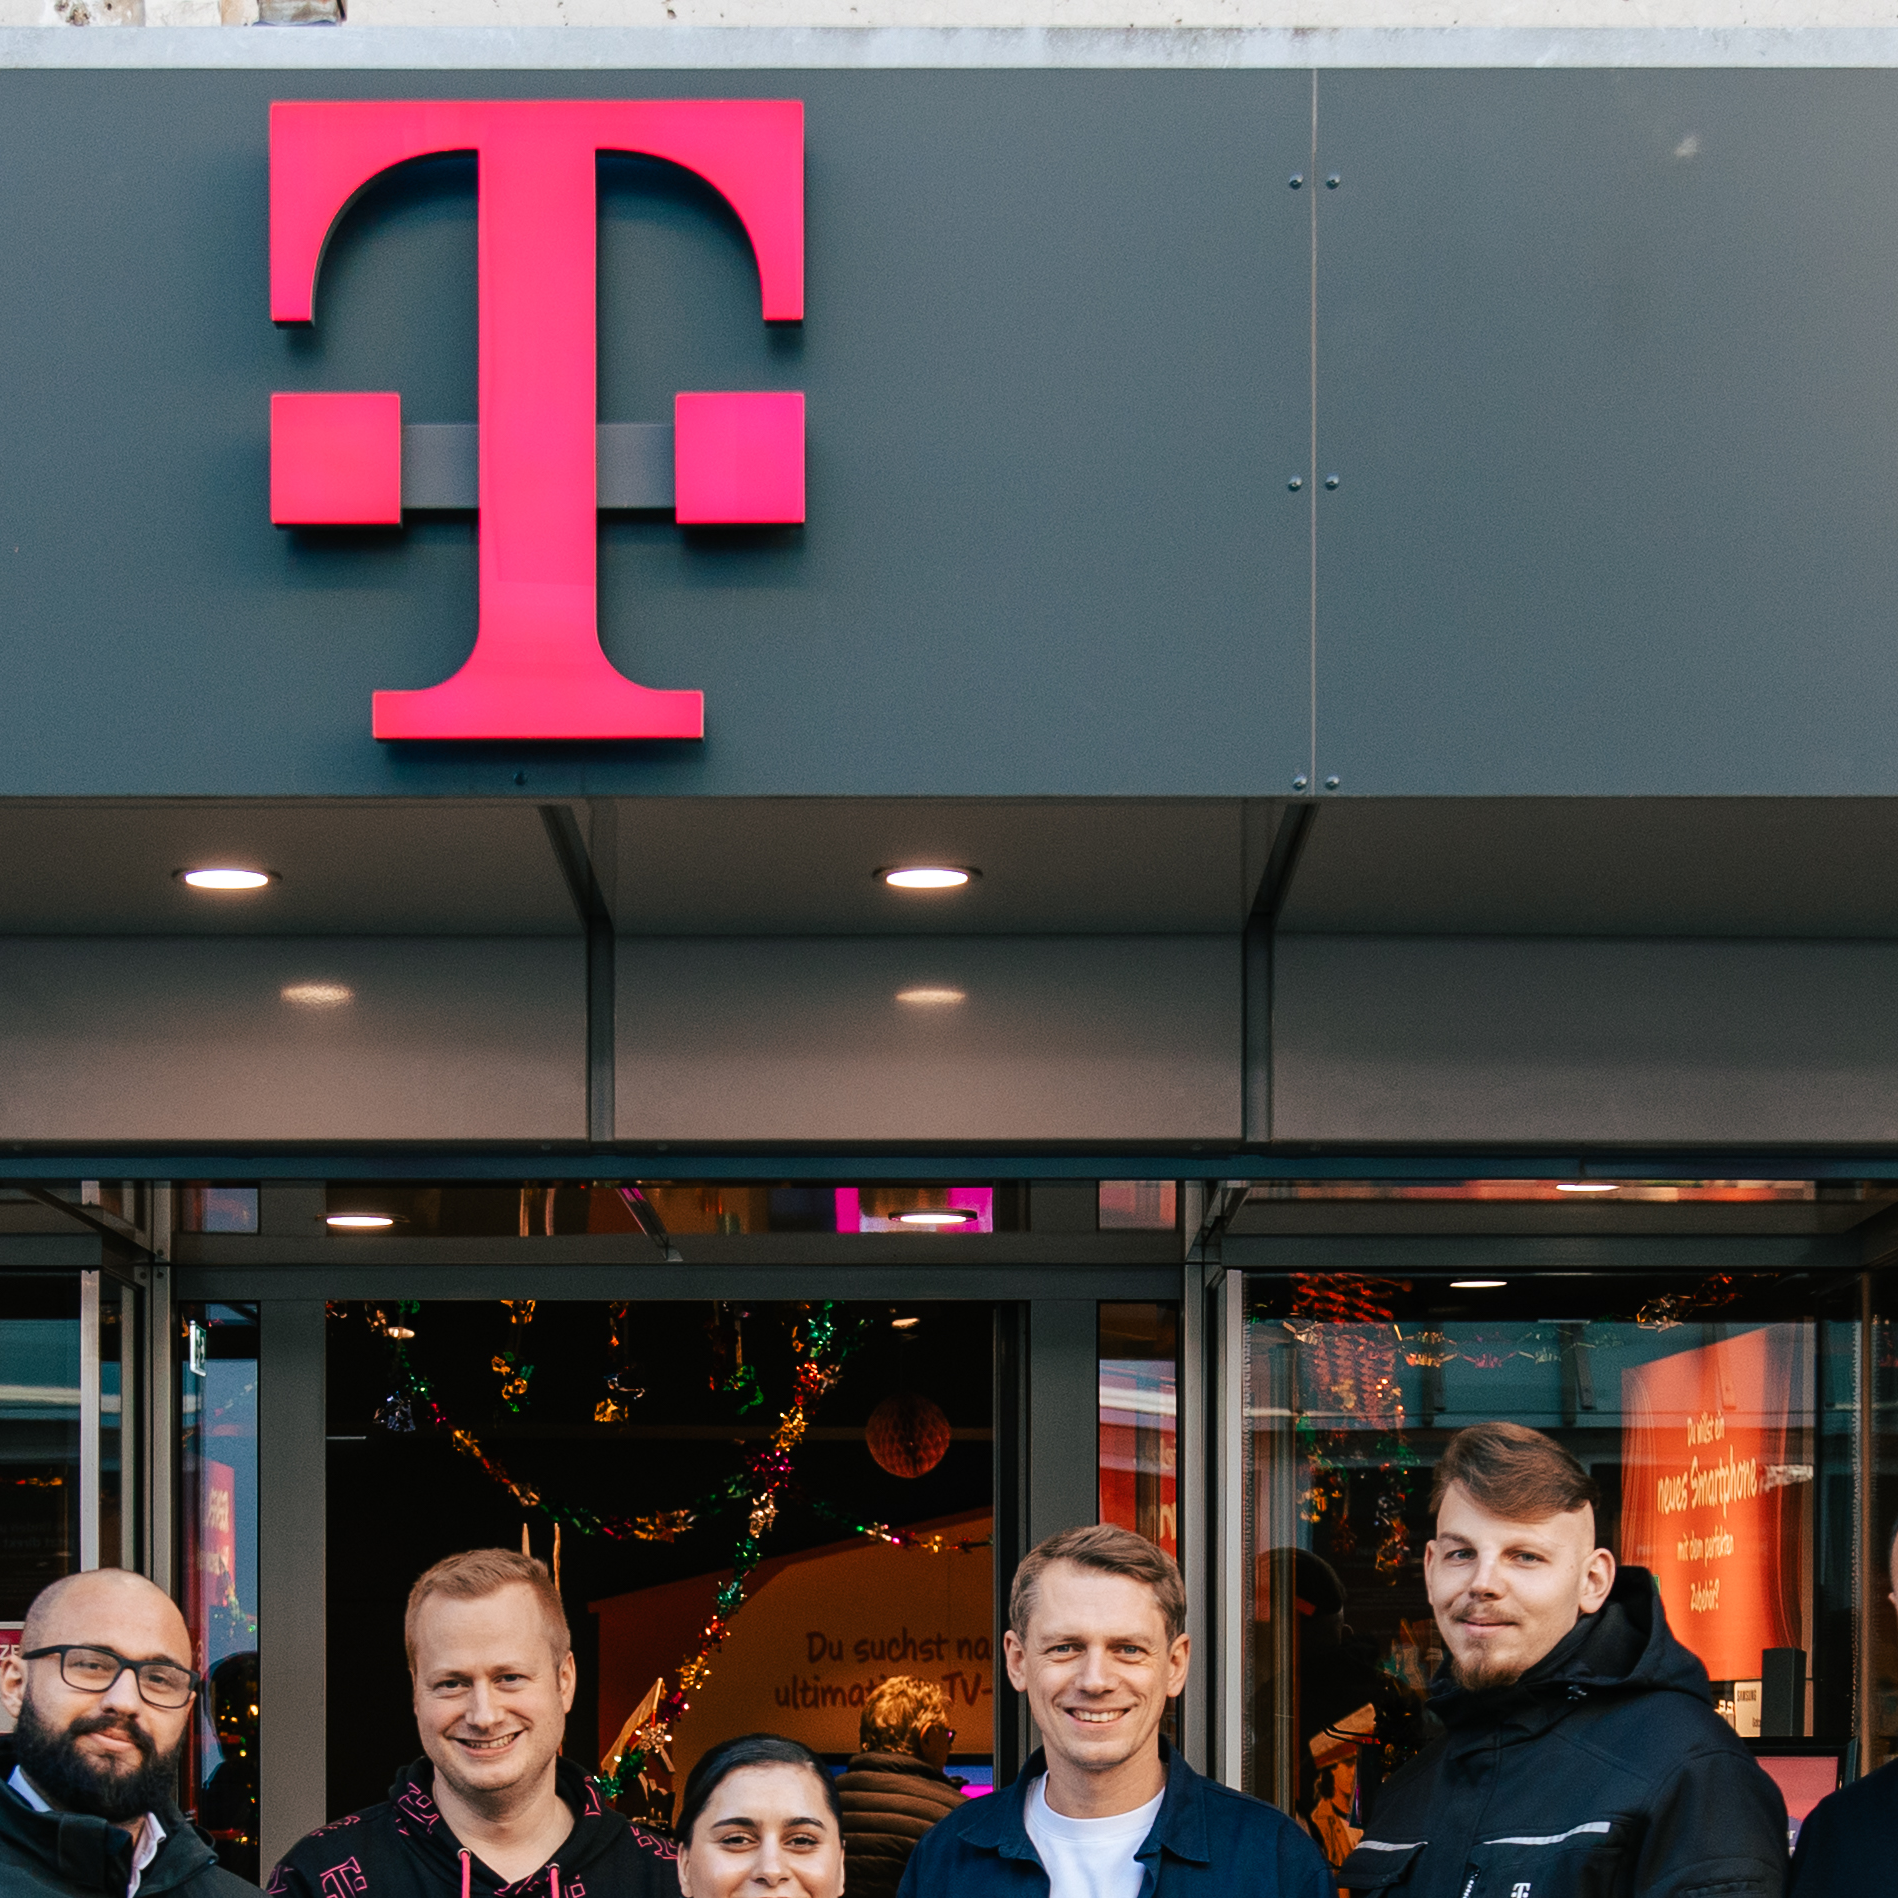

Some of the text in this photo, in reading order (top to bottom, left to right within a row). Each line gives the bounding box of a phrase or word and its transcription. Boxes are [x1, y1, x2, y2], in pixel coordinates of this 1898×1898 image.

[269, 99, 805, 739] T
[1657, 1444, 1758, 1519] neues Smartphone
[1704, 1524, 1735, 1568] perfekten
[1690, 1578, 1720, 1613] Zubehör?
[806, 1626, 994, 1664] Du suchst na
[942, 1671, 993, 1706] TV-
[1737, 1689, 1757, 1703] SAMSUNG
